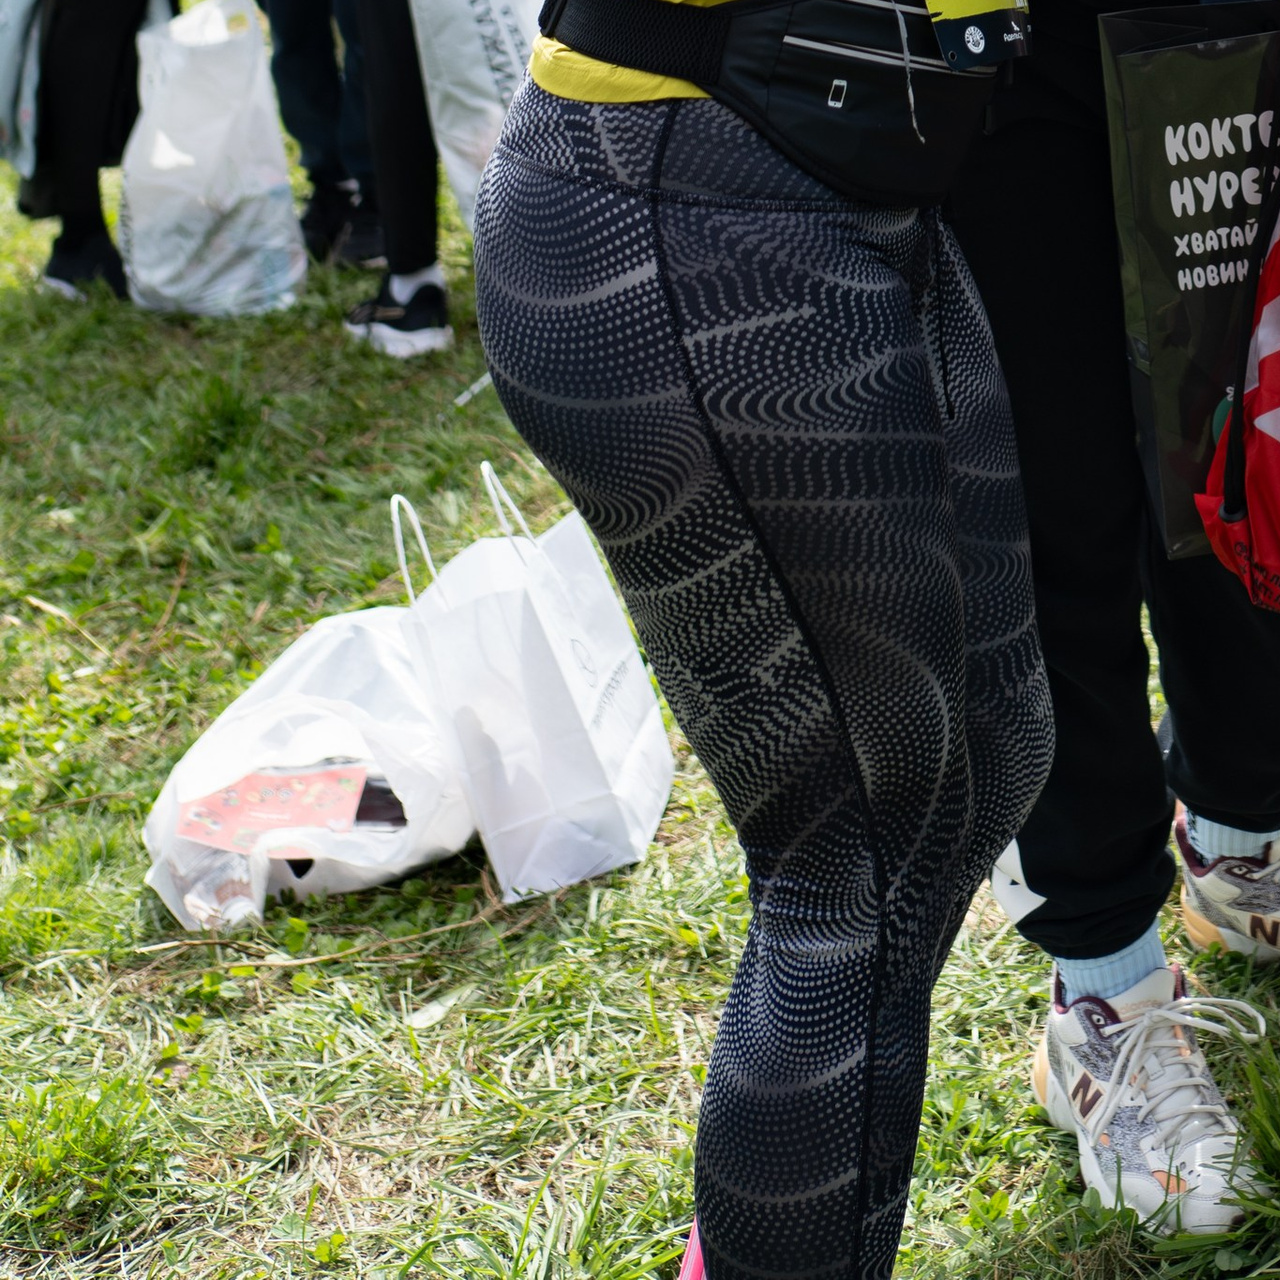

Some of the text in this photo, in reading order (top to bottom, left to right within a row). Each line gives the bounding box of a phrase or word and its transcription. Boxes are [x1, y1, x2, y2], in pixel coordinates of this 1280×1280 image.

[1170, 166, 1280, 218] HYPE
[1173, 218, 1258, 257] ХВАТАЙ
[1177, 258, 1249, 291] НОВИН
